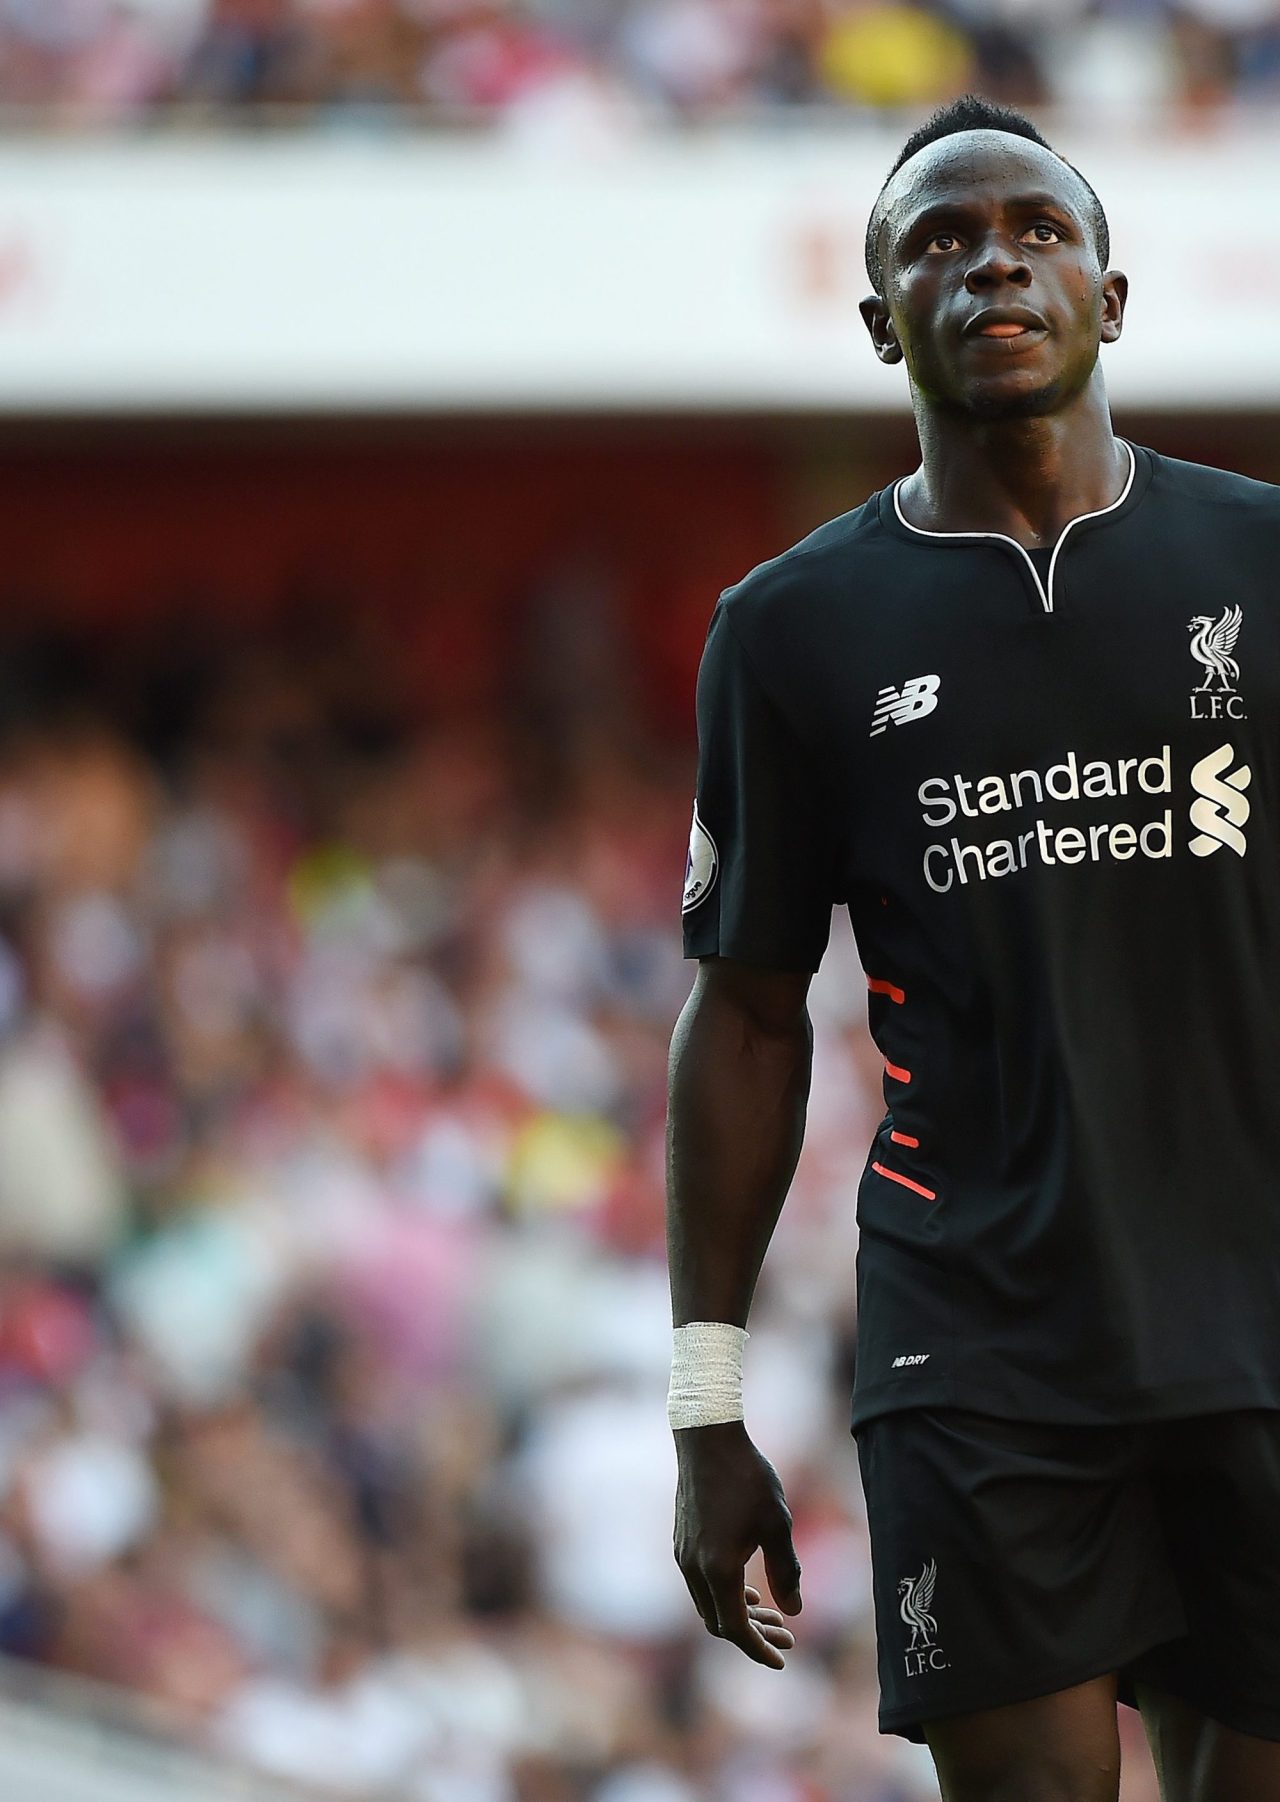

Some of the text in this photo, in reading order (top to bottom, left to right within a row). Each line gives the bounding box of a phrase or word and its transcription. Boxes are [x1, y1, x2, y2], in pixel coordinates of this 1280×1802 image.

[870, 674, 941, 738] NB
[1190, 695, 1248, 720] L.F.C.
[917, 744, 1173, 827] Standard
[923, 809, 1173, 893] Chartered
[904, 1648, 952, 1677] L.F.C.
